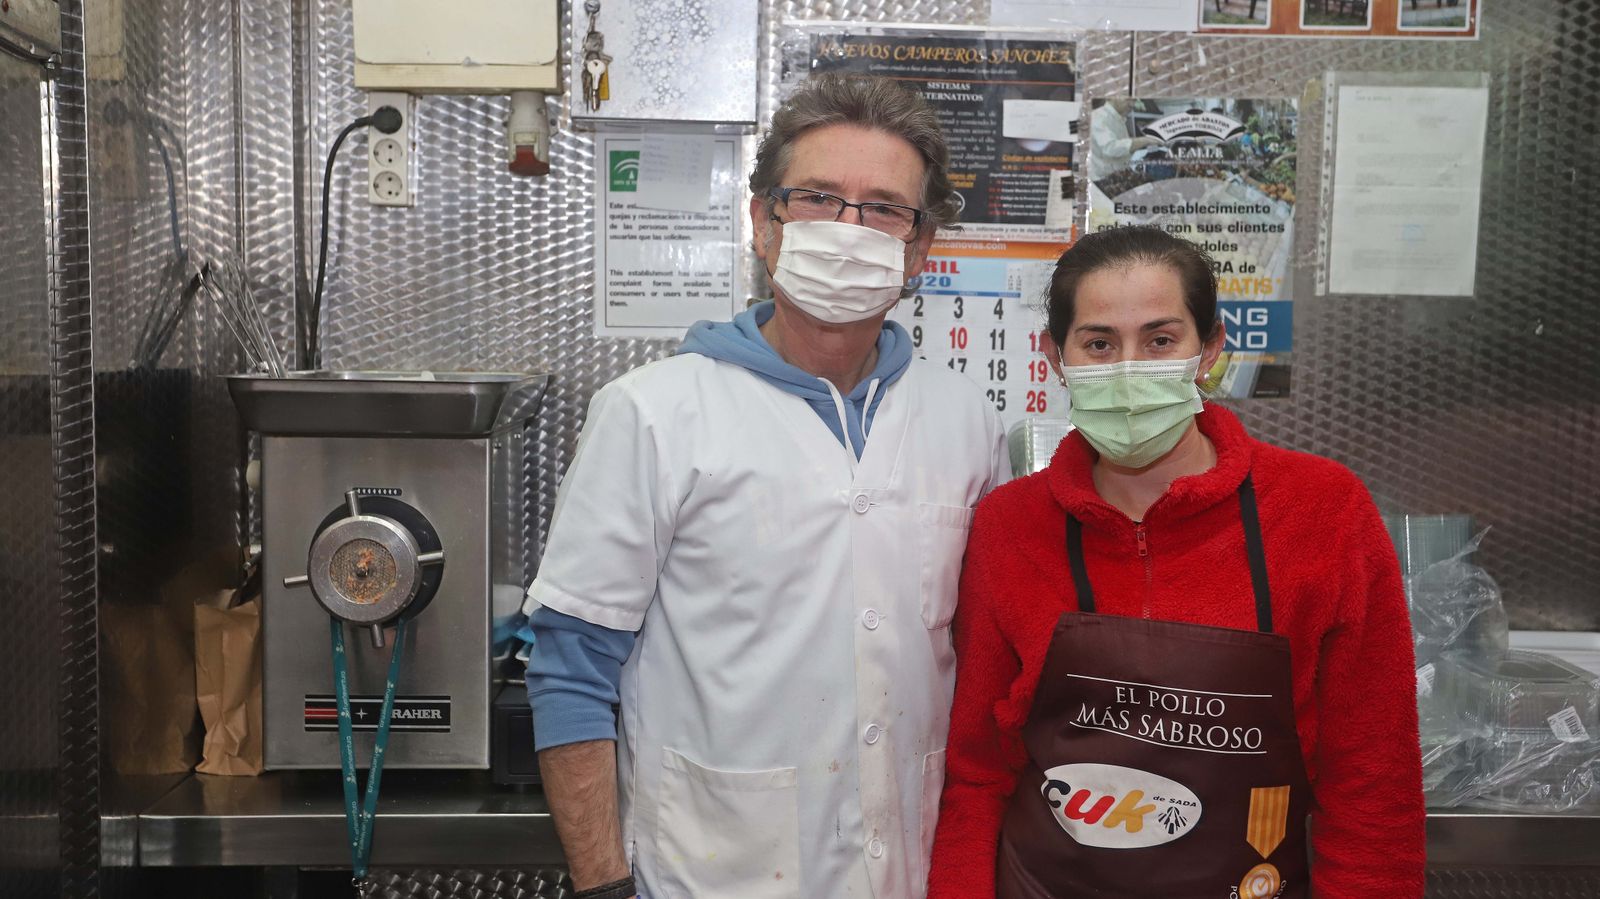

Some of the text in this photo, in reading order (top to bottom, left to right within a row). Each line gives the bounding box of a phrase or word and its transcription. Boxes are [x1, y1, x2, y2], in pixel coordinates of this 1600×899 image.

[894, 45, 984, 64] CAMPEROS
[927, 82, 971, 91] SISTEMAS
[1114, 202, 1271, 215] Este establecimiento
[639, 224, 668, 232] personas
[1167, 223, 1191, 233] con
[1197, 224, 1223, 233] sus
[1228, 222, 1285, 234] clientes
[1194, 240, 1238, 252] ndoles
[609, 269, 623, 277] This
[628, 269, 673, 277] establishment
[926, 260, 960, 274] RIL
[1239, 261, 1256, 273] de
[609, 280, 642, 288] complaint
[683, 280, 712, 288] available
[1216, 277, 1273, 295] RATIS
[705, 291, 730, 299] request
[914, 295, 1004, 320] 2 3 4
[1220, 307, 1268, 326] NG
[913, 325, 1041, 352] 9 10 11 1
[988, 359, 1007, 381] 18
[1028, 360, 1047, 382] 19
[1026, 390, 1047, 413] 26
[1115, 686, 1226, 717] EL POLLO
[391, 708, 442, 719] RAHER
[1076, 703, 1262, 750] MÁS SABROSO
[1152, 795, 1198, 808] de SADA
